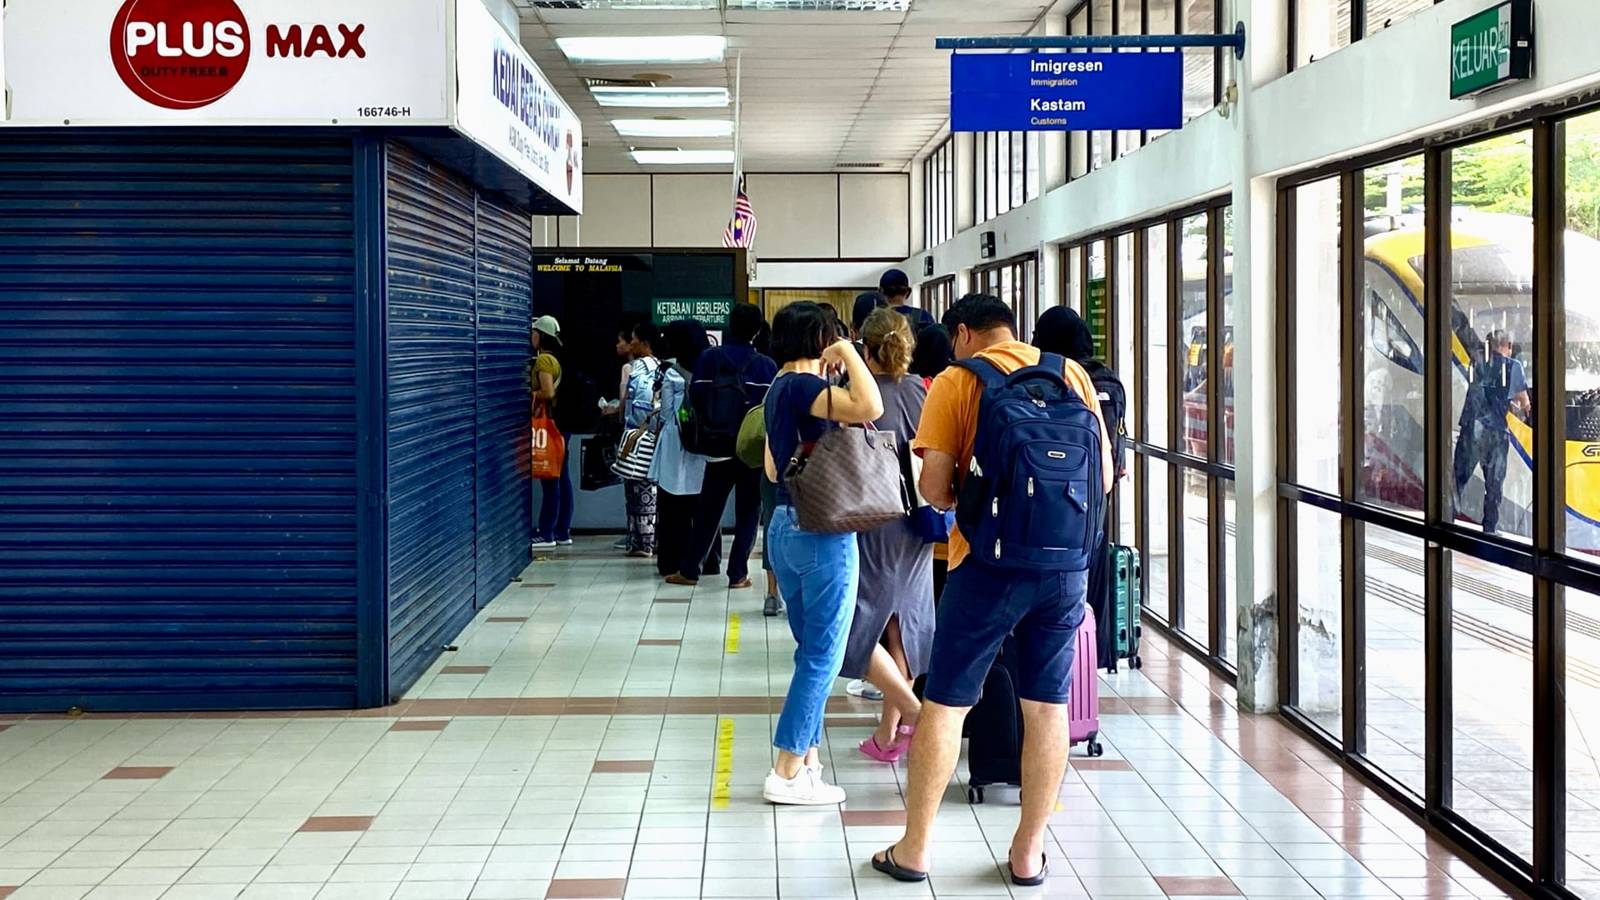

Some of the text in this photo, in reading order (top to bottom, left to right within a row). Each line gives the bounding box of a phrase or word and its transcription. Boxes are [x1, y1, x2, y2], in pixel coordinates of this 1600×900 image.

[127, 20, 366, 58] PLUS MAX
[1452, 27, 1498, 81] KELUAR
[141, 65, 216, 77] DUTY FREE
[1031, 59, 1103, 74] Imigresen
[493, 47, 519, 118] KEDAI
[1031, 78, 1078, 88] Immigration
[1031, 98, 1086, 111] Kastam
[357, 106, 411, 117] 166746-H
[1031, 116, 1067, 125] Customs
[537, 264, 623, 272] WELCOME TO MALAYSIA
[656, 301, 691, 315] KETIBAAN
[696, 301, 730, 315] BERLEPAS
